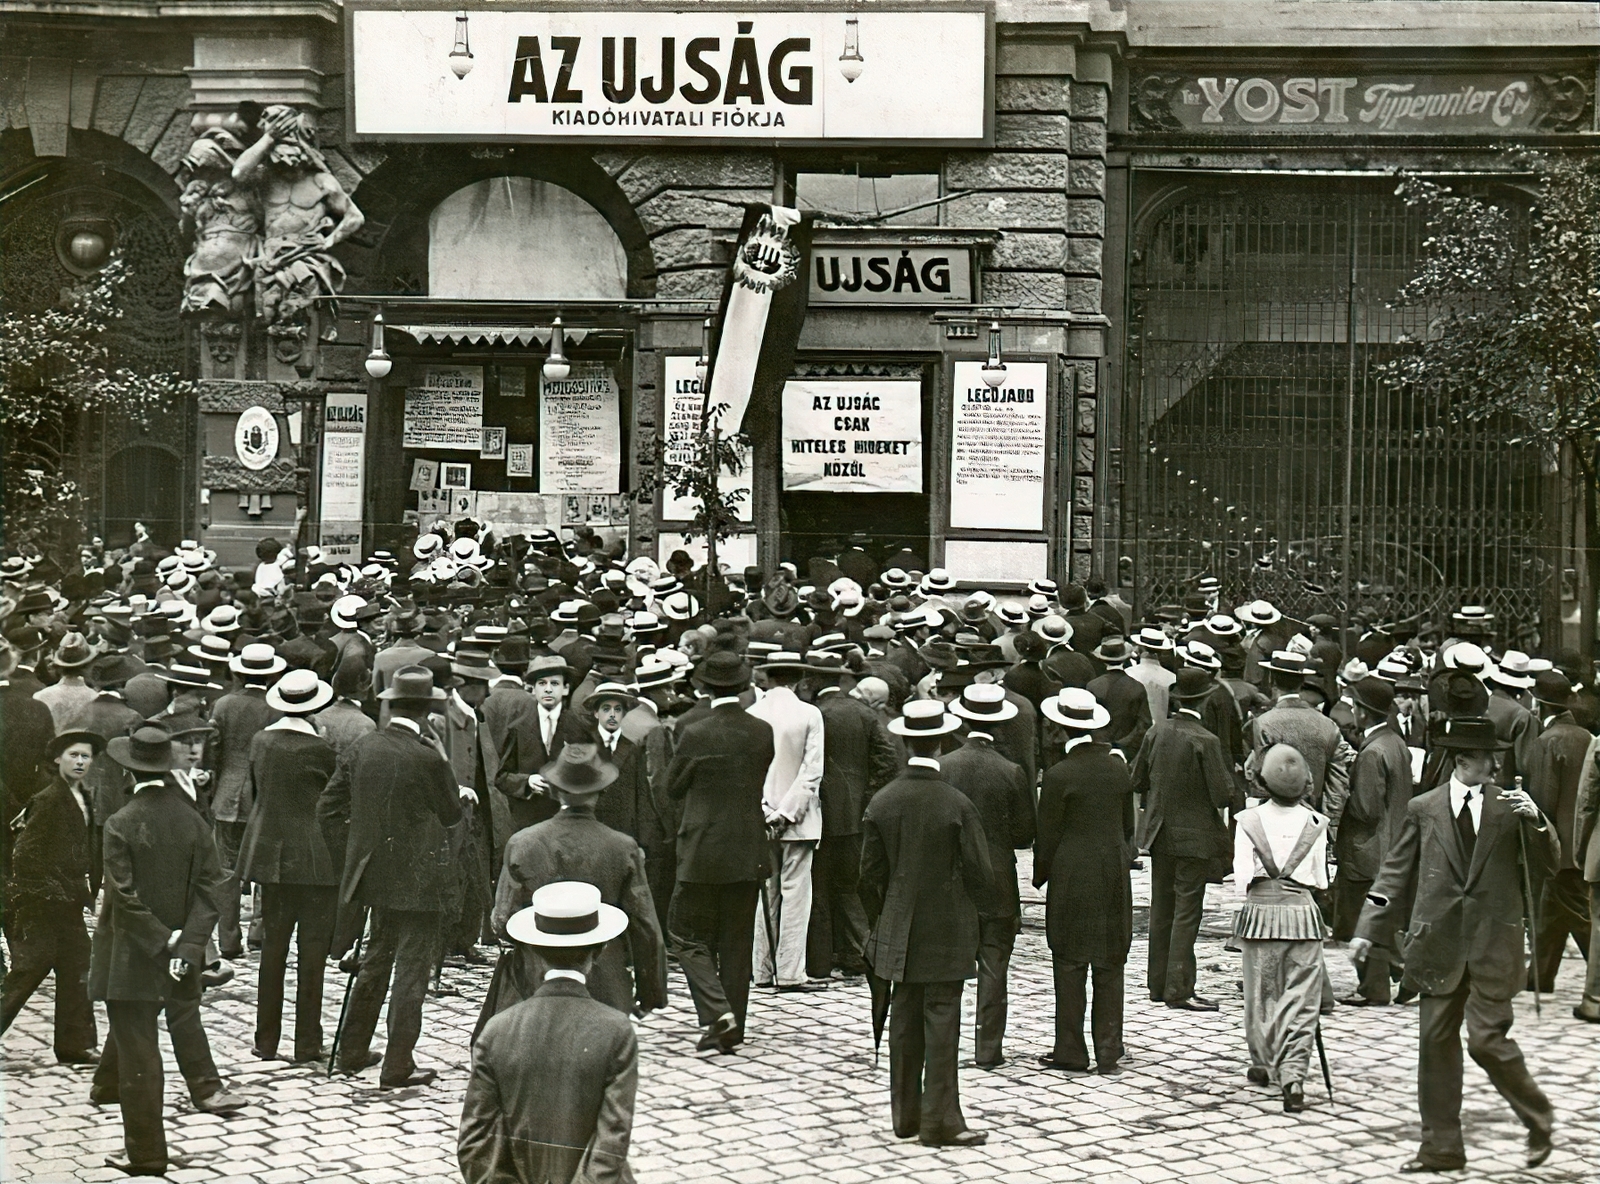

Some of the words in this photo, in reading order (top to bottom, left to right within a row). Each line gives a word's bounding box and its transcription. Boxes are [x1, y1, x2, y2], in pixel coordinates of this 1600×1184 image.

[508, 36, 582, 103] AZ
[602, 21, 814, 106] UJSÁG
[552, 108, 705, 127] KIADÓHIVATALI
[711, 107, 786, 128] FIÓKJA
[1197, 77, 1358, 123] YOST
[1359, 83, 1497, 130] Typewriter
[815, 250, 951, 293] UJSÁG
[812, 396, 832, 410] AZ
[834, 416, 870, 431] CSAK
